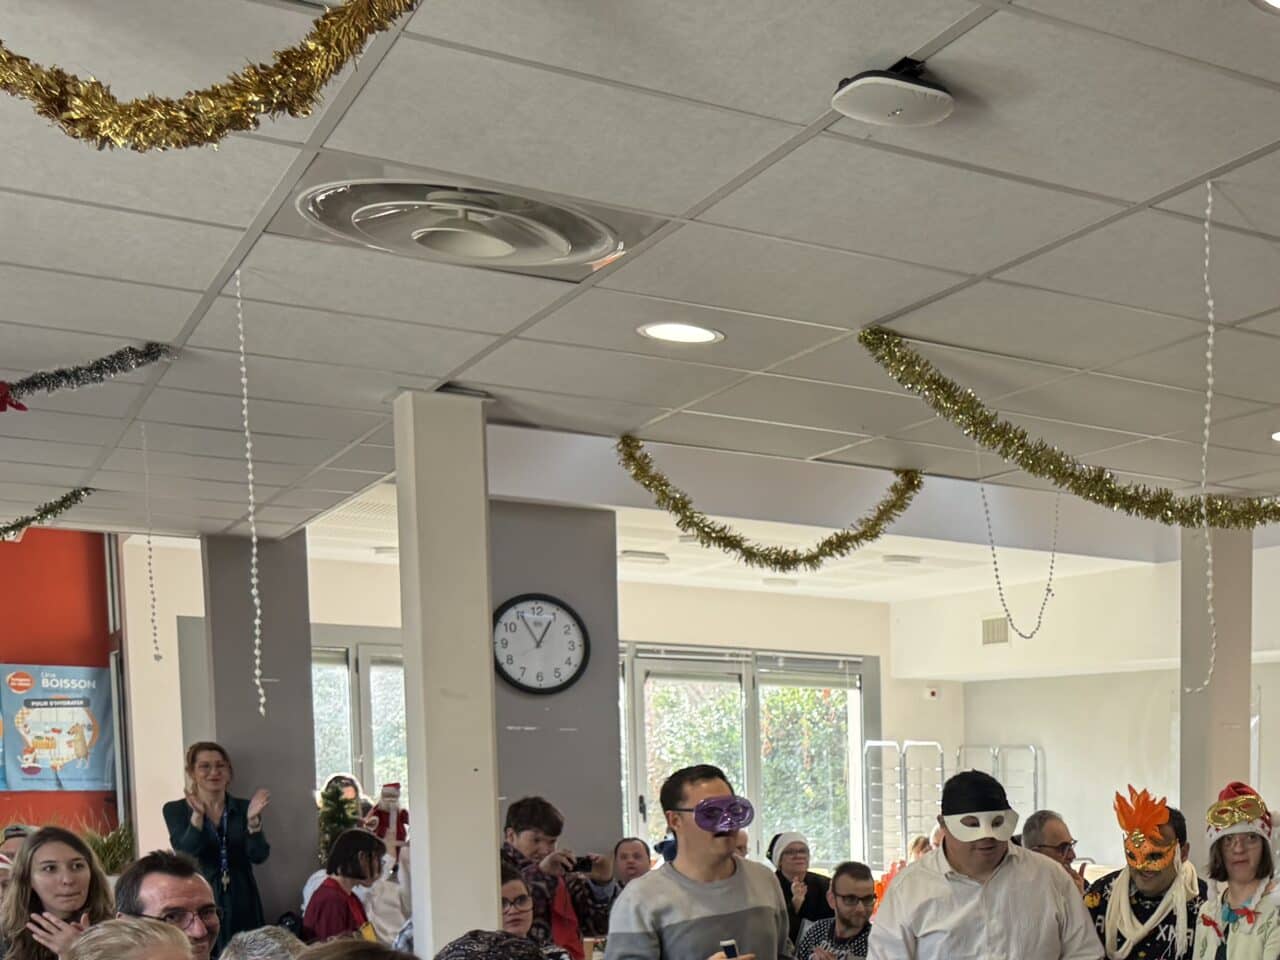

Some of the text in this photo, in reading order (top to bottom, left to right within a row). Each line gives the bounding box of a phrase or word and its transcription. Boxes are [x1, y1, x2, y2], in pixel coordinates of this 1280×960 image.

[531, 606, 544, 616] 12
[503, 622, 517, 633] 10
[563, 624, 571, 635] 2
[500, 638, 509, 649] 9
[568, 640, 576, 651] 3
[505, 654, 514, 665] 8
[564, 657, 572, 666] 4
[519, 666, 527, 678] 7
[536, 671, 544, 682] 6
[553, 667, 561, 679] 5
[41, 678, 96, 689] BOISSON
